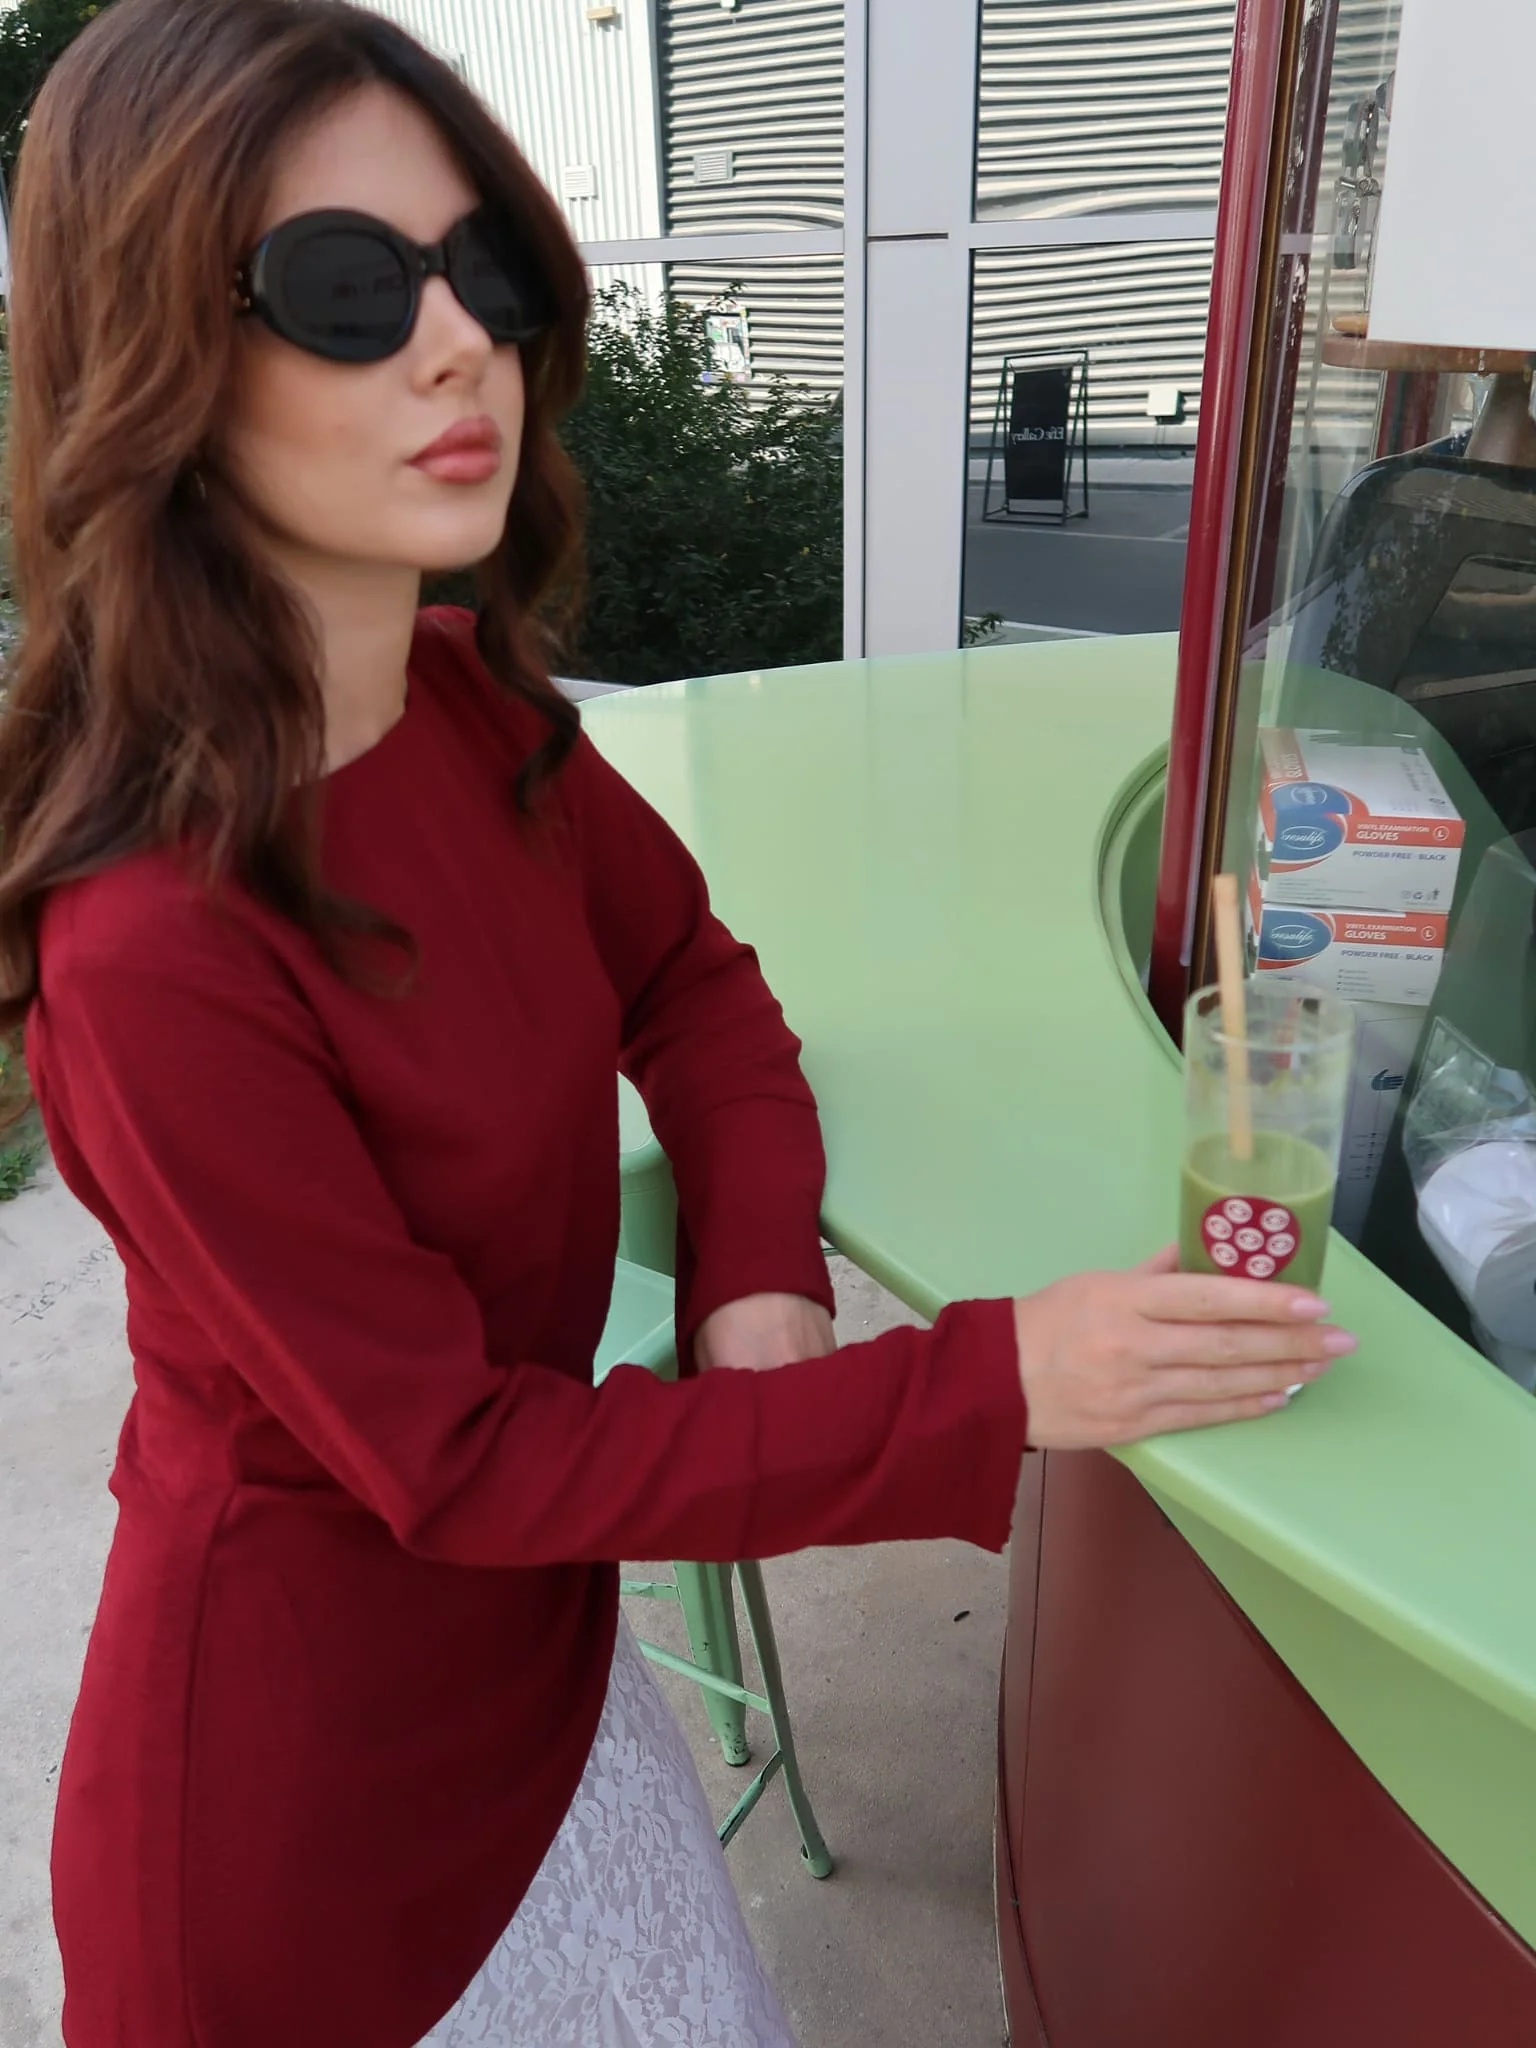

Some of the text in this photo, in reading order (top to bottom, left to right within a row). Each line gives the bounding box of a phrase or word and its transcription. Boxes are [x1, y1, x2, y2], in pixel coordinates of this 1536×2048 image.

[1356, 830, 1400, 841] GLOVES
[1352, 850, 1447, 861] POWDER FREE BLACK
[1344, 930, 1387, 940] GLOVES
[1341, 949, 1434, 961] POWDER FREE BLACK
